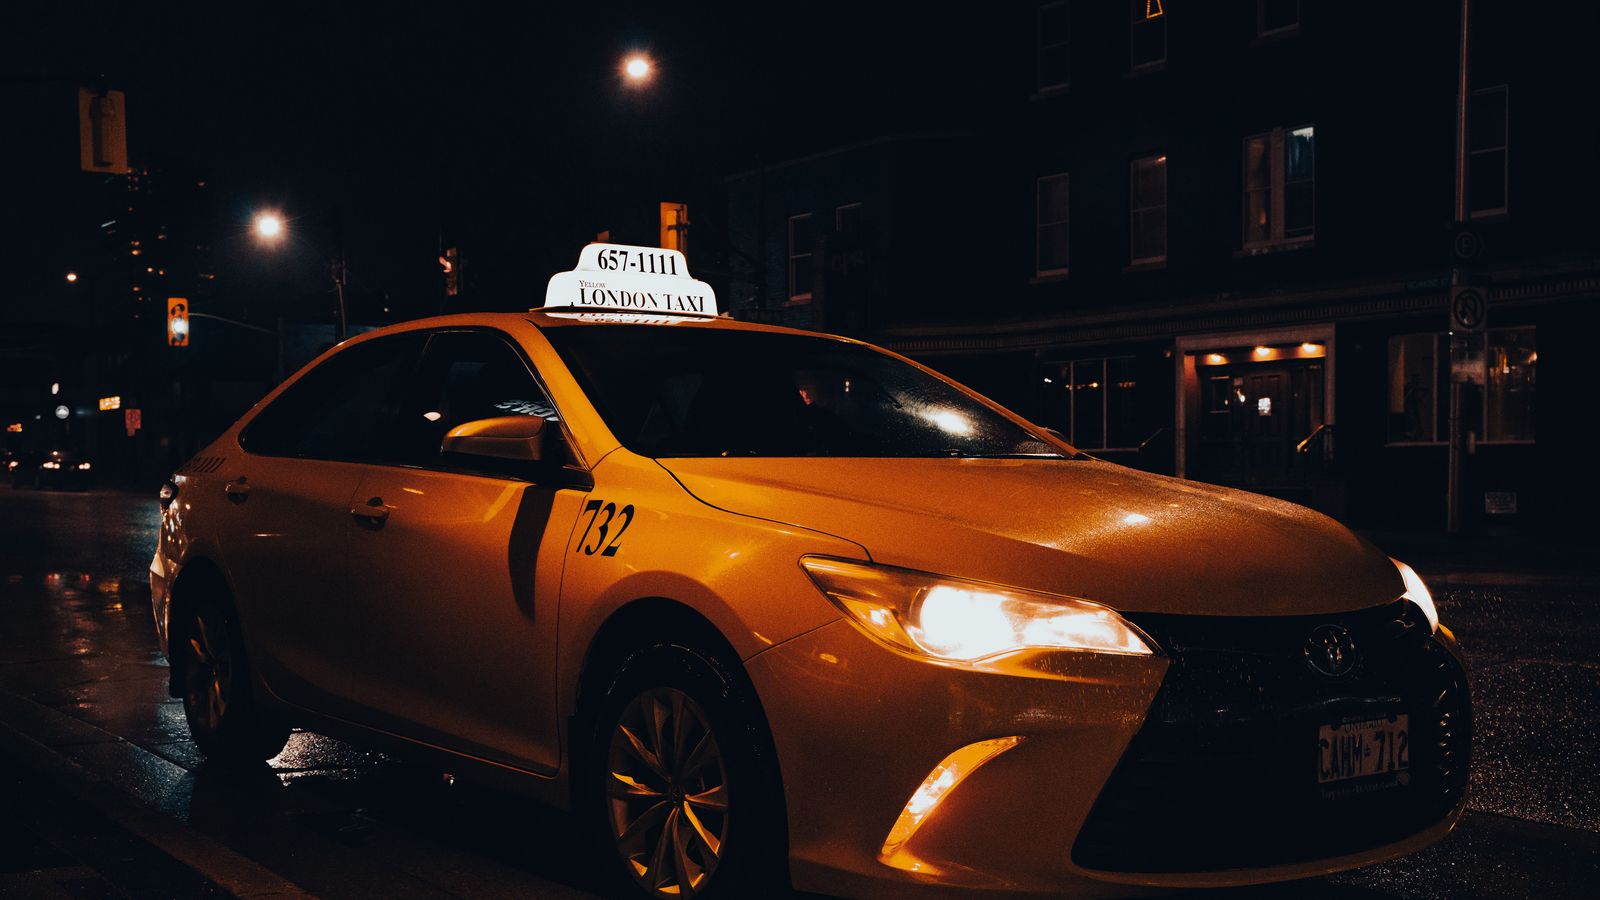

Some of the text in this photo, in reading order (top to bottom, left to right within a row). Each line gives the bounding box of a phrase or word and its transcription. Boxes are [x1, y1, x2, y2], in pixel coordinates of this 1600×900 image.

[598, 249, 678, 275] 657-1111
[580, 288, 704, 312] LONDON TAXI
[576, 500, 634, 556] 732
